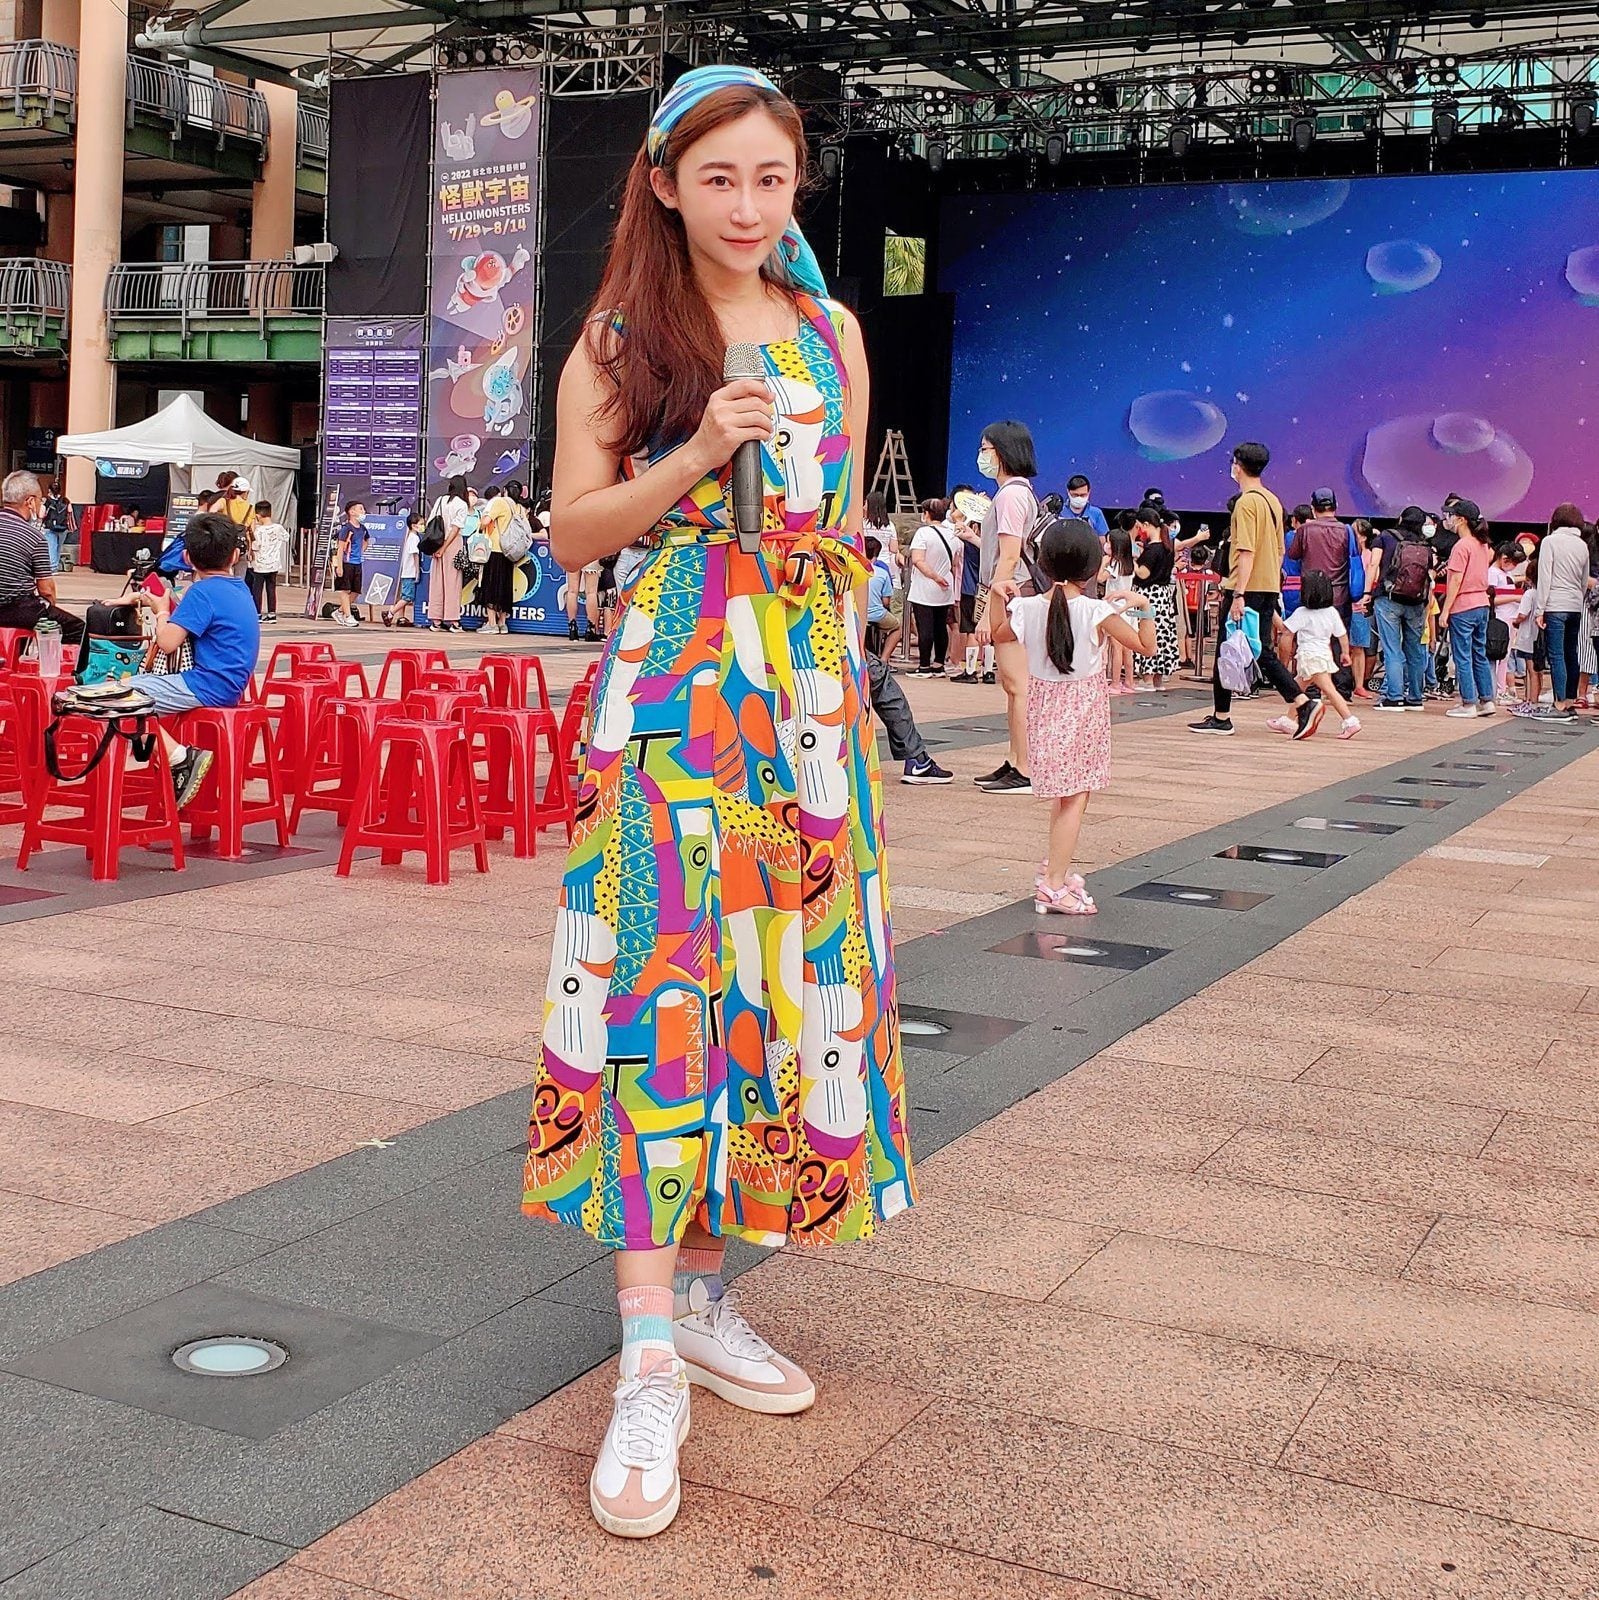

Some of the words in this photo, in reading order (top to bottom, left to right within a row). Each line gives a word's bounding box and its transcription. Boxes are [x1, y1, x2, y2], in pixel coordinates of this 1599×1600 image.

[451, 170, 471, 181] 2022
[439, 174, 530, 212] 怪獸宇宙
[441, 203, 531, 225] HELLO!MONSTERS
